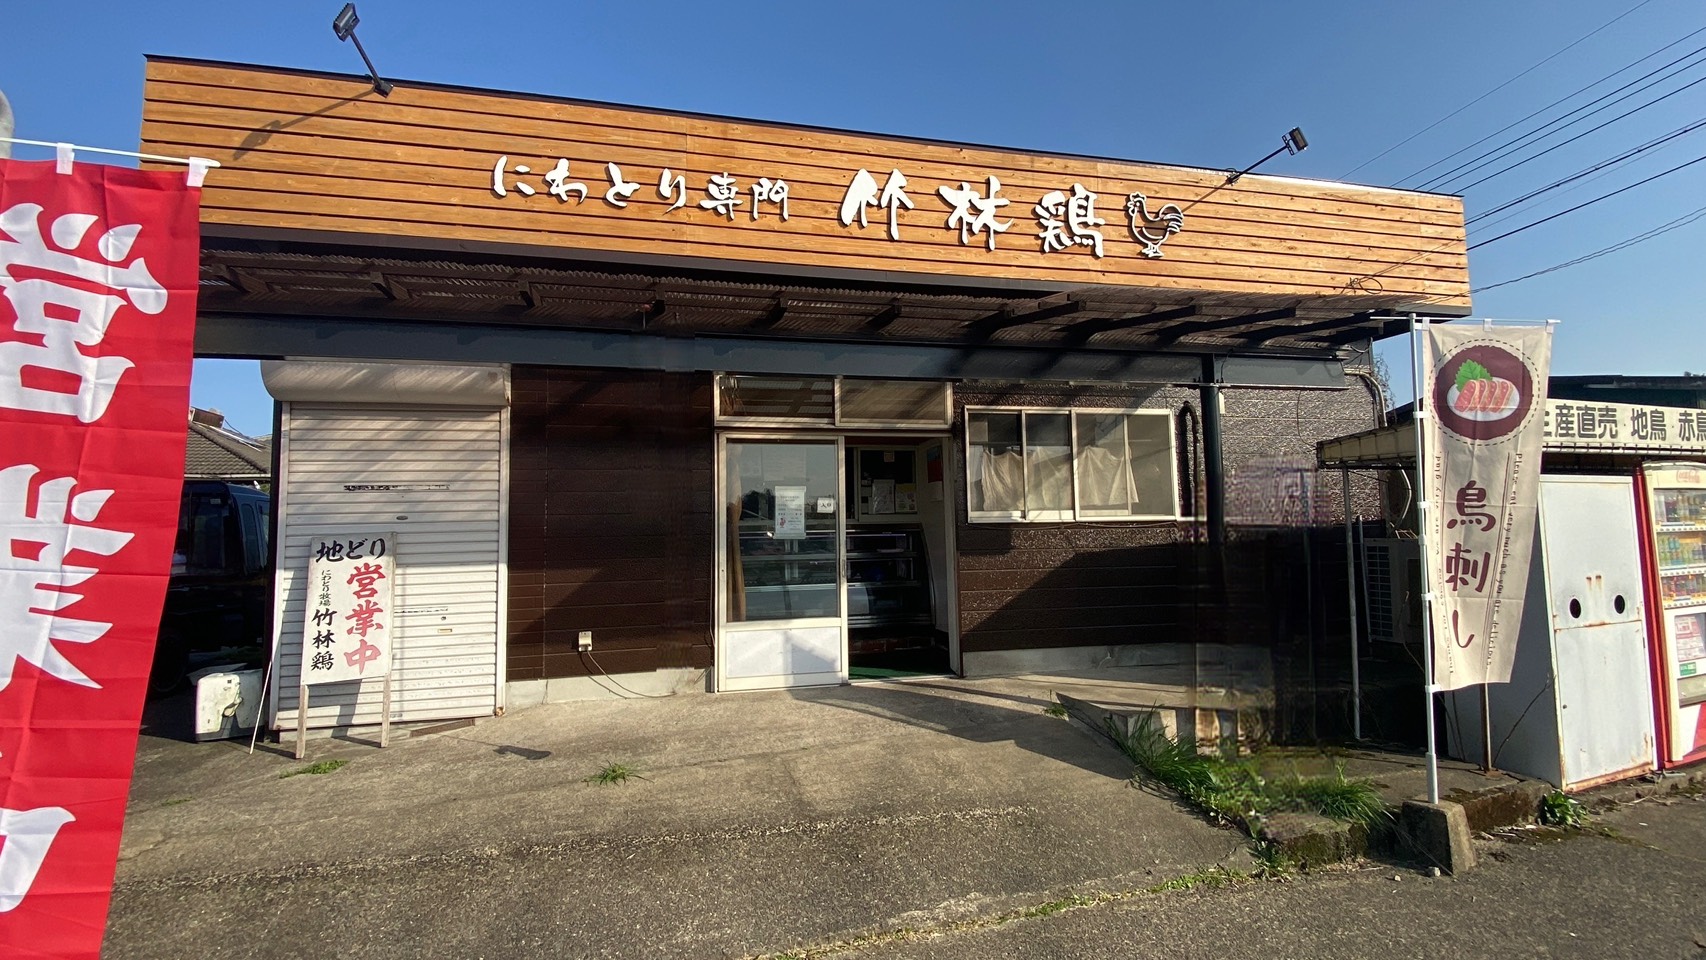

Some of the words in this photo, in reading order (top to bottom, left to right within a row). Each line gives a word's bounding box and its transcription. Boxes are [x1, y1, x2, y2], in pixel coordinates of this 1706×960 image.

[492, 154, 790, 222] にわとり専門
[840, 168, 1105, 258] 竹林鶏
[0, 202, 168, 913] 営業
[316, 538, 386, 563] 地どり
[1446, 480, 1496, 649] 鳥刺し
[1495, 579, 1504, 594] you
[311, 607, 337, 672] 竹林鶏
[344, 562, 386, 675] 営業中
